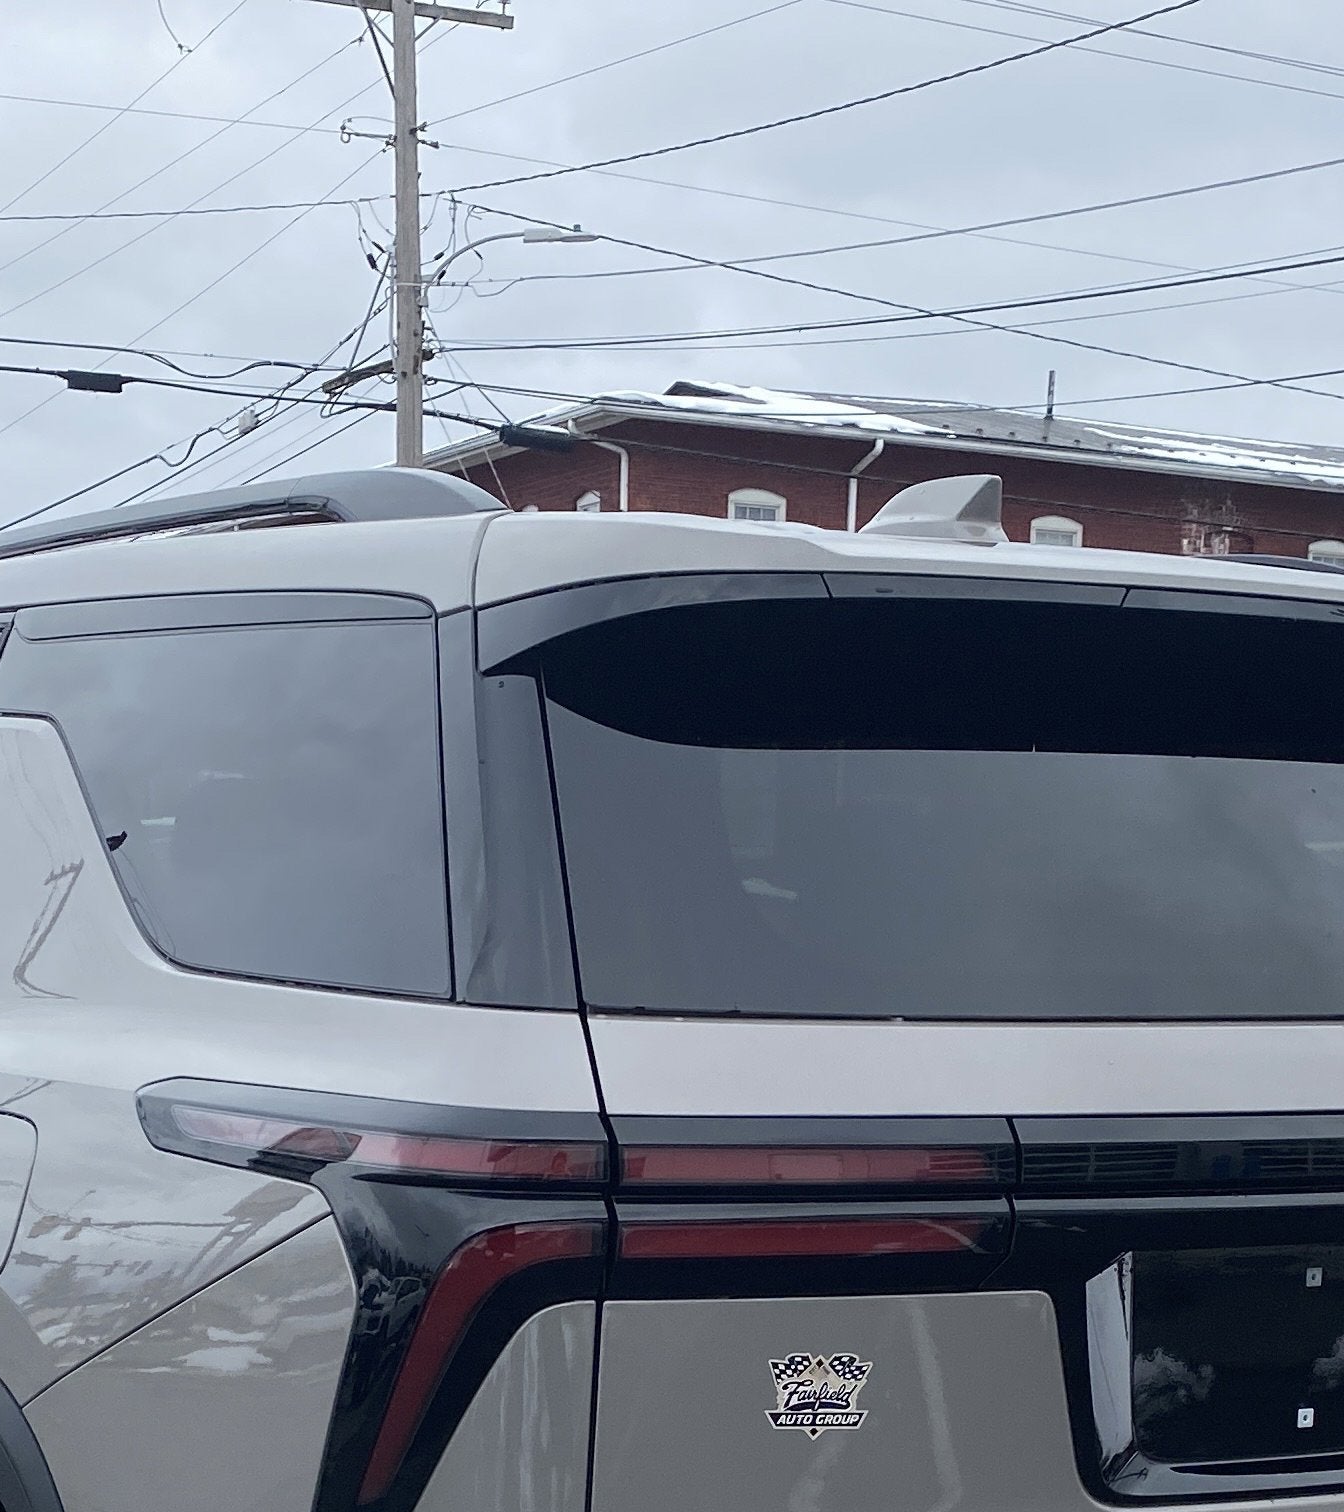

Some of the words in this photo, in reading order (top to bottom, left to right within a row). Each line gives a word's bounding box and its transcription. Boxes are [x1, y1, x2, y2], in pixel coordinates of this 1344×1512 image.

[781, 1379, 858, 1411] Fairfield
[776, 1414, 813, 1425] AUTO
[815, 1414, 860, 1425] GROUP
